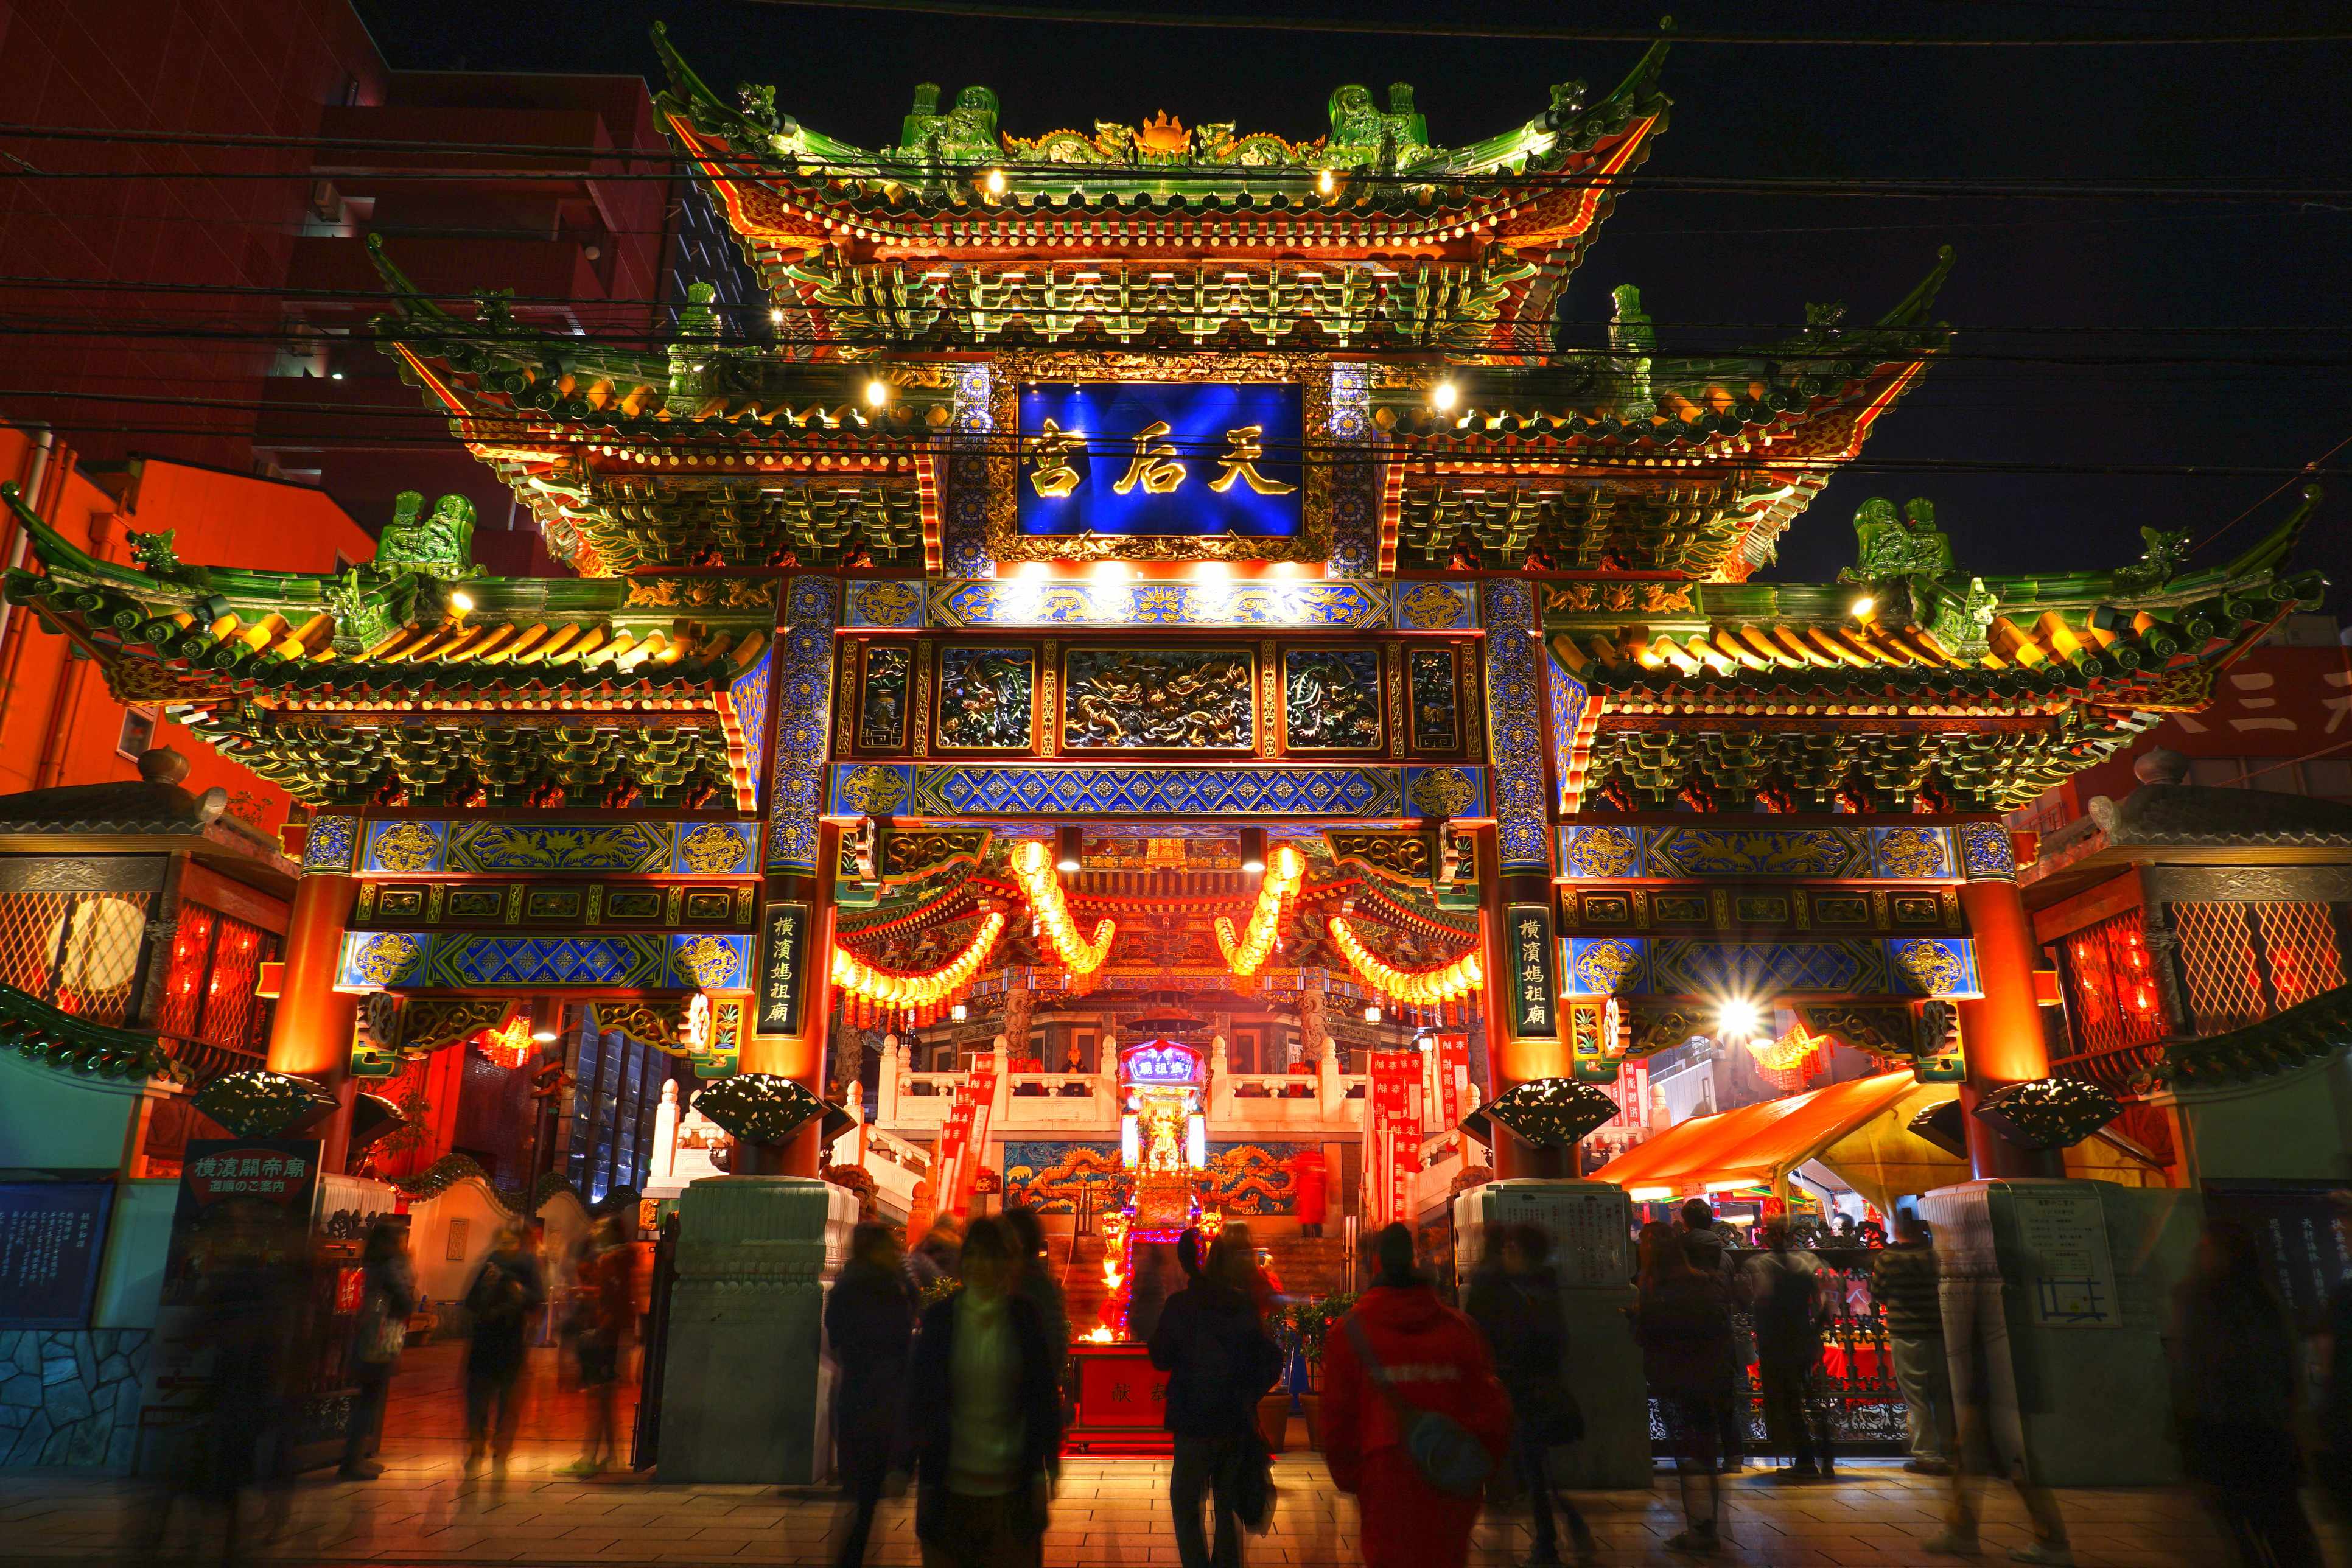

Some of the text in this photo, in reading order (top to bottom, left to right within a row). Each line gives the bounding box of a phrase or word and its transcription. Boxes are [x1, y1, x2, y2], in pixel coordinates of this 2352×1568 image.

[1022, 418, 1298, 497] 天后宮
[765, 917, 796, 1023] 横濱媽祖廟
[1518, 919, 1545, 1025] 横濱媽祖廟
[209, 1180, 285, 1193] 道順のご案内
